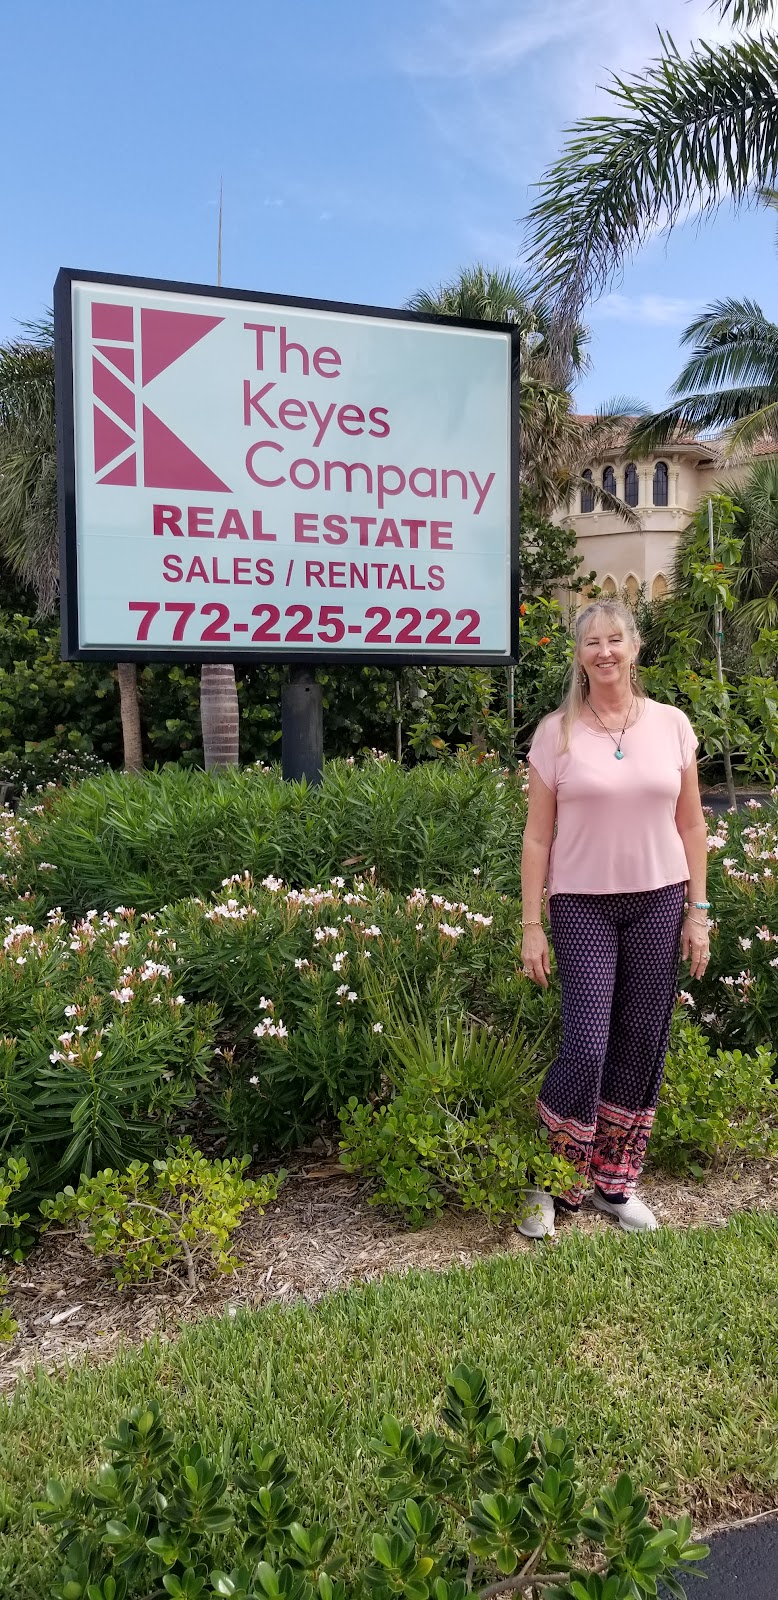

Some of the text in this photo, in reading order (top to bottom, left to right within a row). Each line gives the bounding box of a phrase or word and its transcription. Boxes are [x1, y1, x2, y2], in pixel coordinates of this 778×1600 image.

[243, 322, 343, 380] The
[242, 379, 391, 448] Keyes
[244, 440, 496, 515] Company
[152, 504, 454, 551] REAL ESTATE
[162, 554, 446, 592] SALES / RENTALS
[128, 601, 482, 645] 772-225-2222
